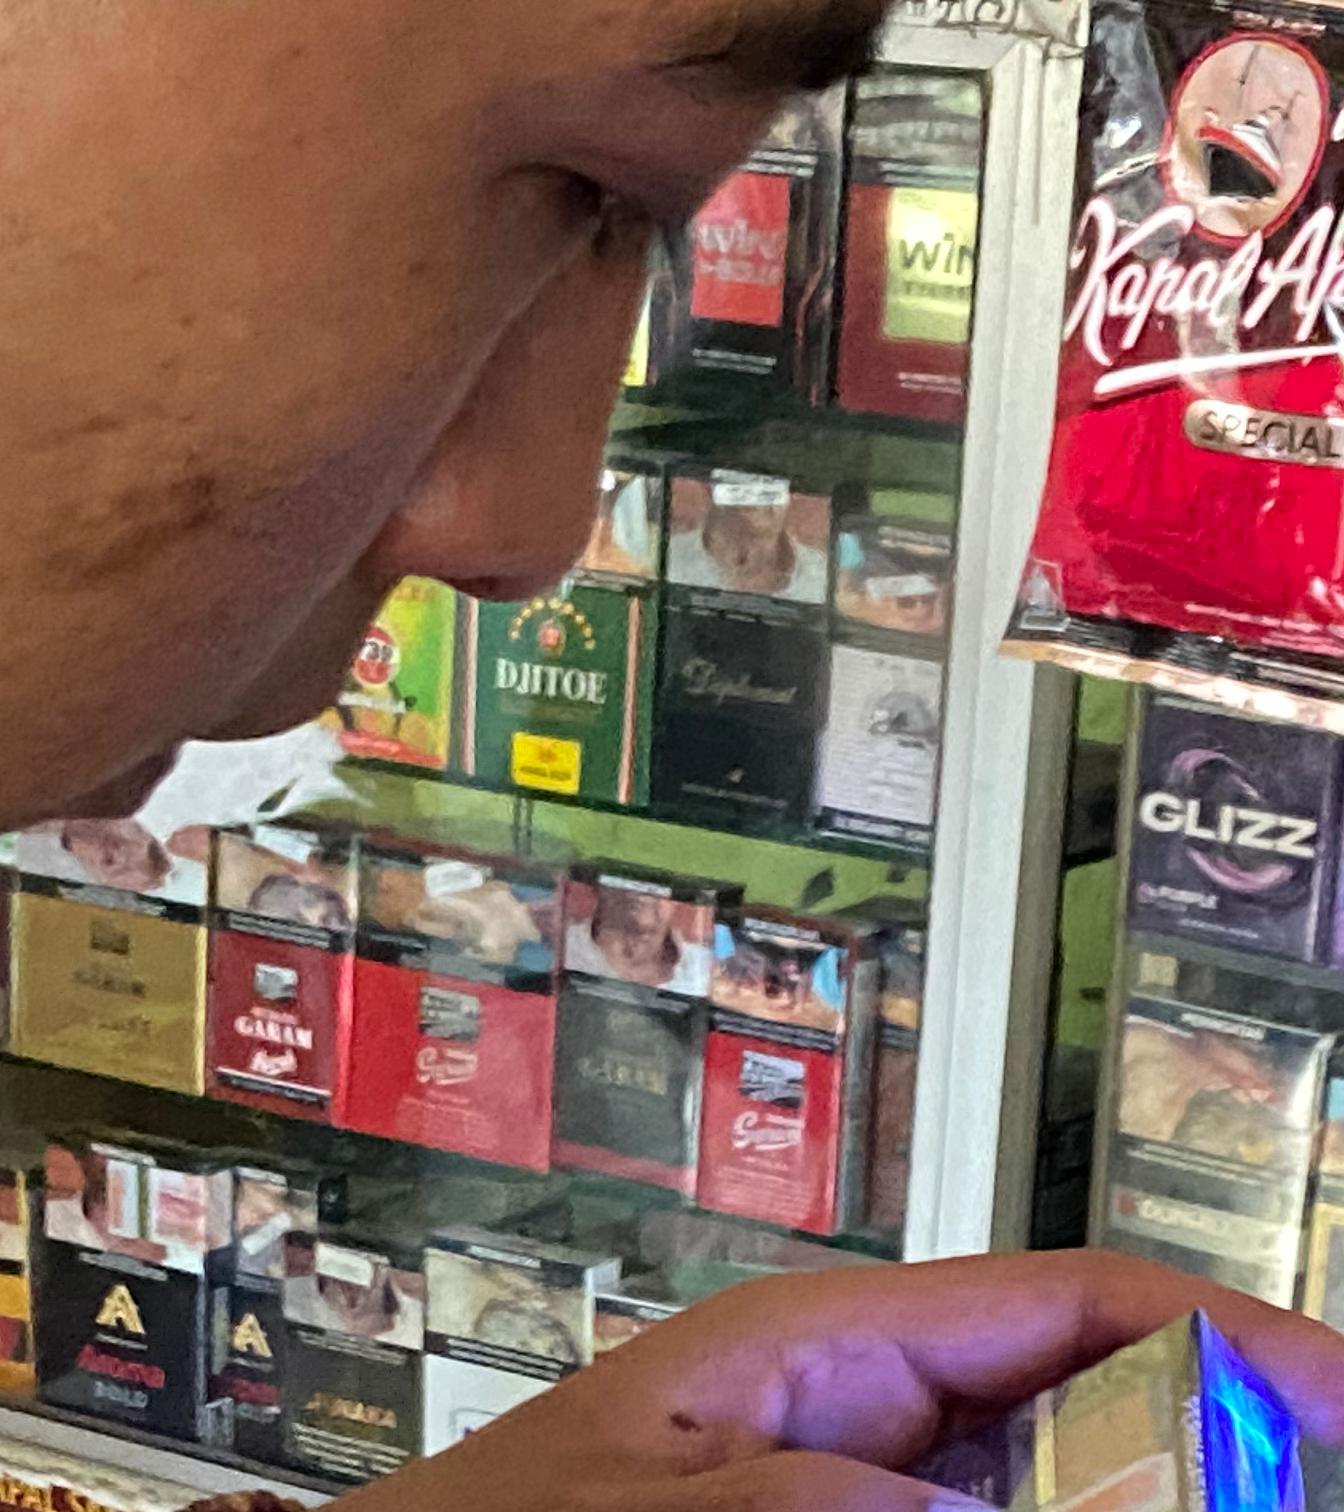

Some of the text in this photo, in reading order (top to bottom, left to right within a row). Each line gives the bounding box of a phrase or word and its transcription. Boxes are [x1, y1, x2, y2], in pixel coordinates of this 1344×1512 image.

[1062, 196, 1264, 367] Kapal
[1200, 411, 1342, 460] SPECIAL
[494, 656, 608, 705] DJITOE
[1138, 790, 1318, 858] GLIZZ
